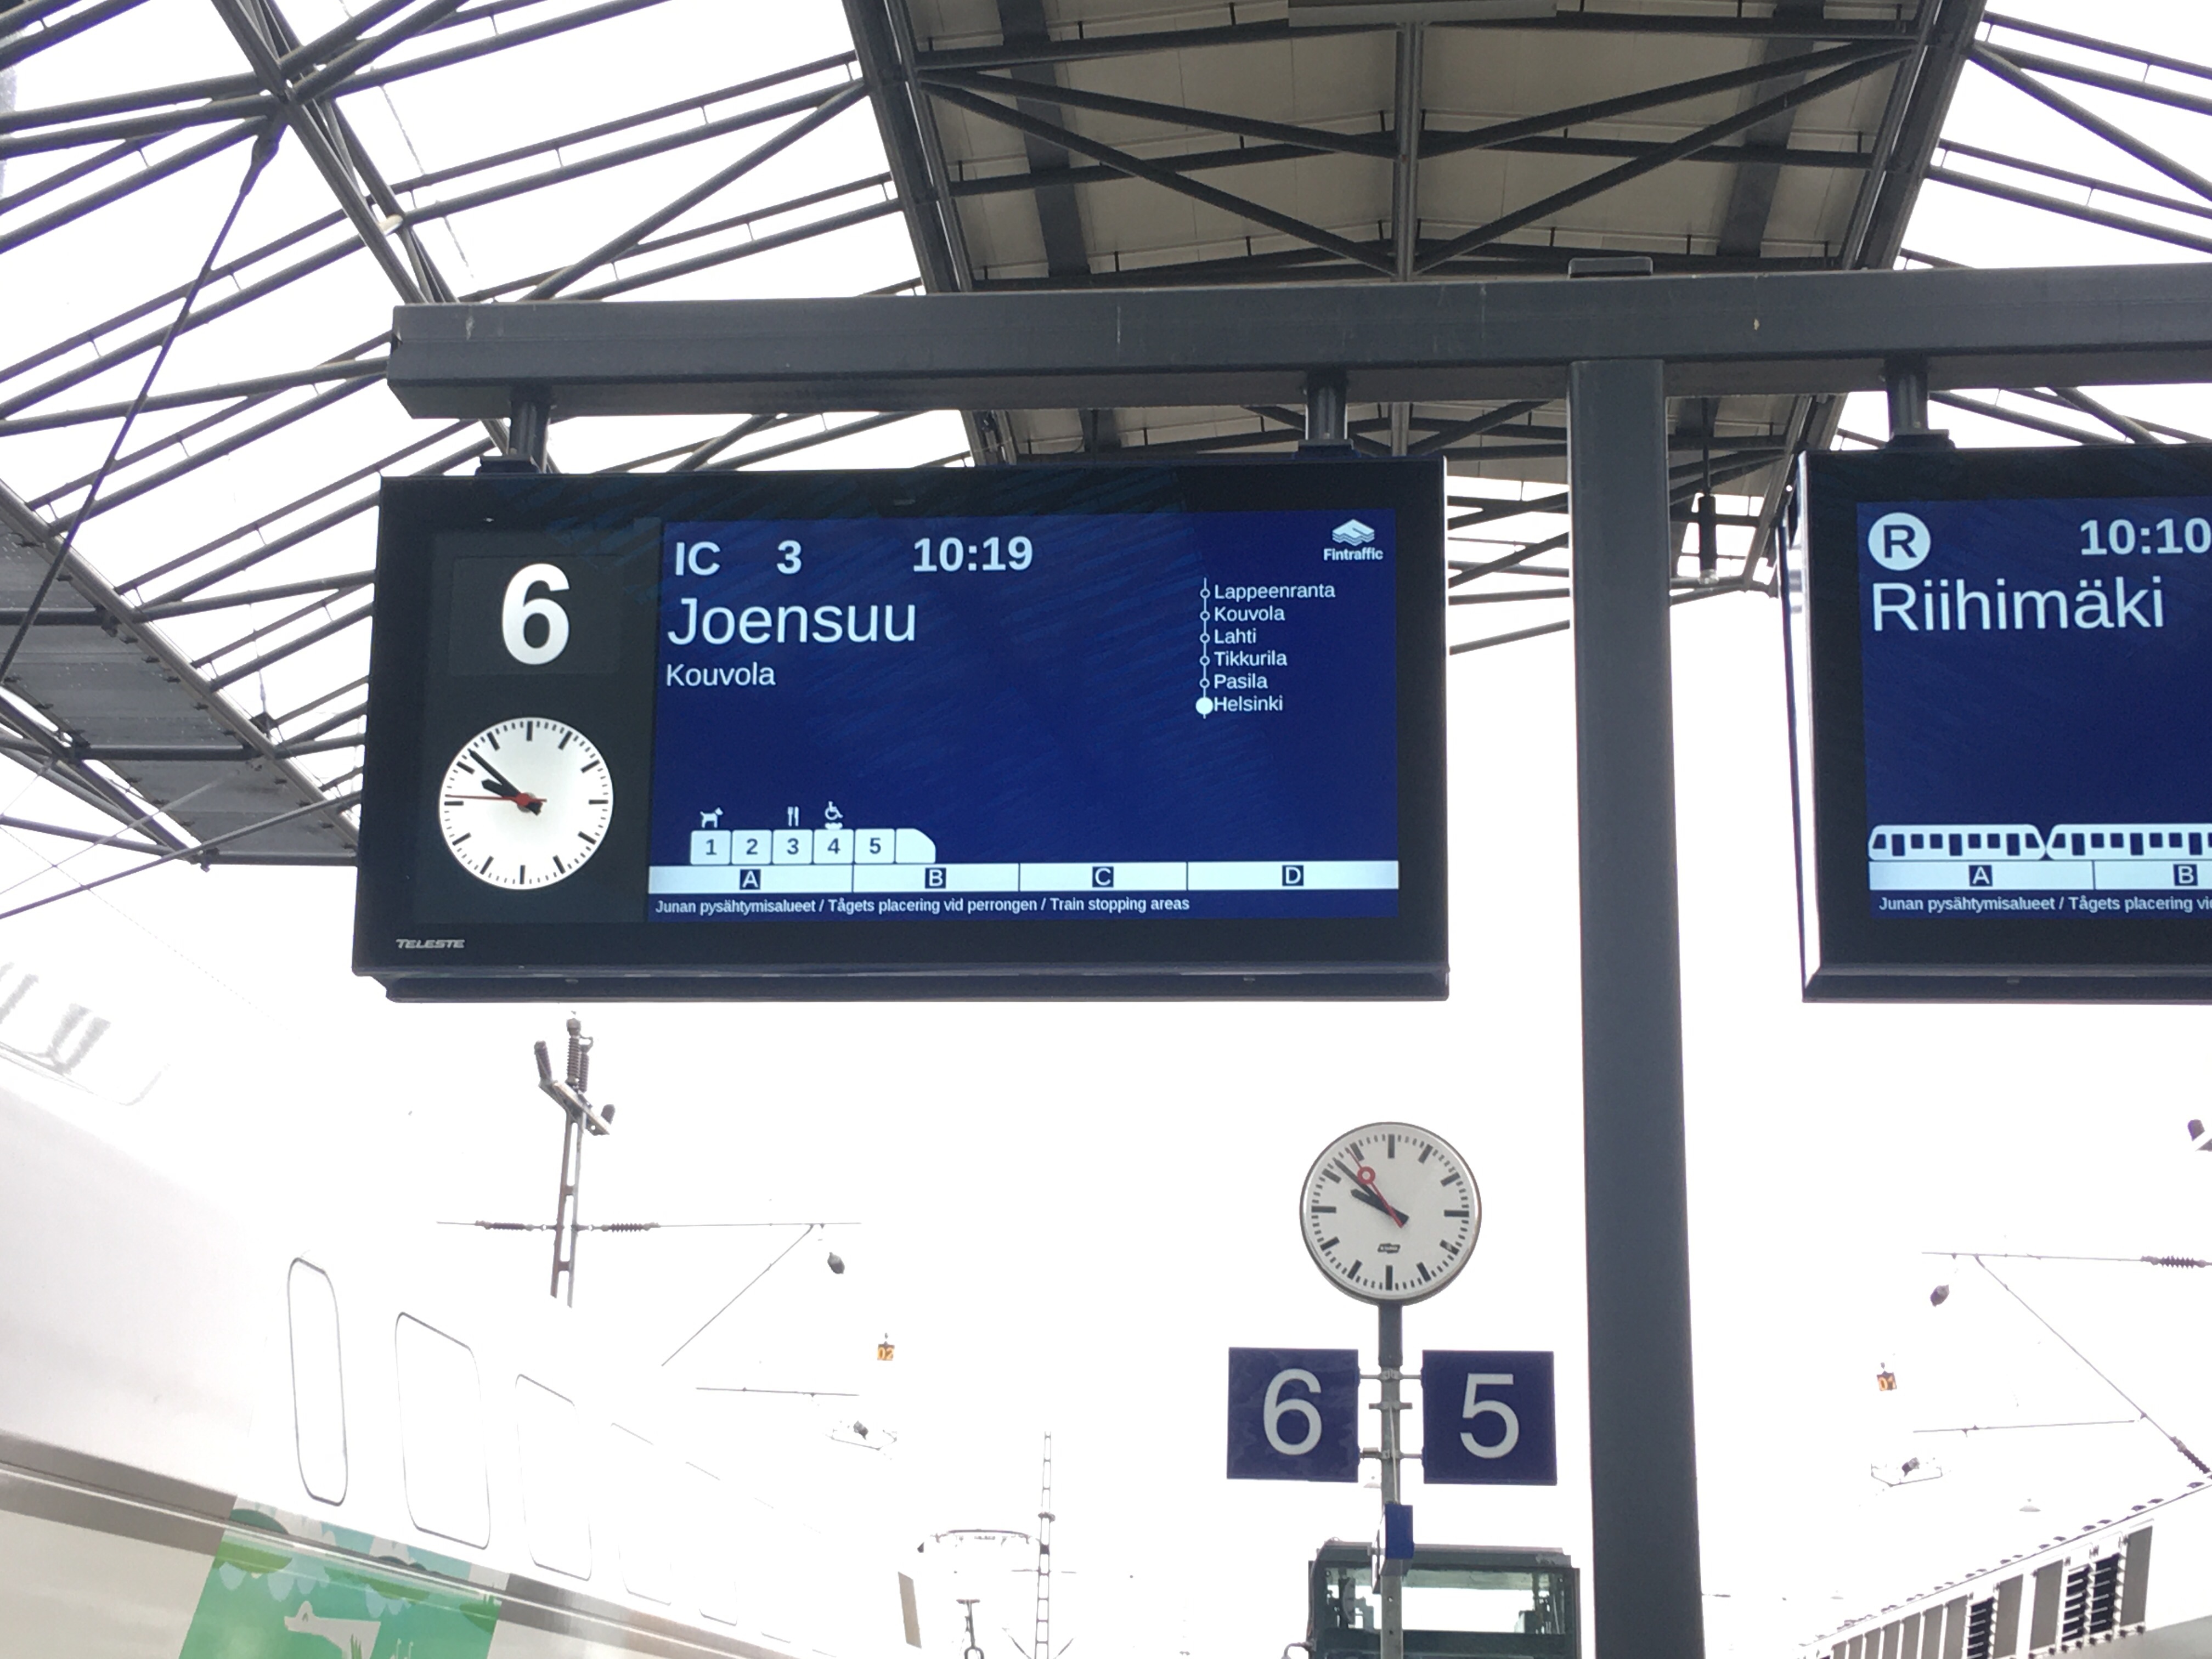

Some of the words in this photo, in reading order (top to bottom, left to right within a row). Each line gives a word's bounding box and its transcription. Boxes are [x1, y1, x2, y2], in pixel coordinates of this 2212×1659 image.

[2080, 517, 2211, 555] 10:10
[675, 541, 720, 575] IC
[776, 540, 802, 574] 3
[913, 536, 1032, 572] 10:19
[1323, 546, 1384, 561] Fintraffic
[1215, 584, 1336, 602] Lappeenranta
[1873, 575, 2163, 631] Riihimäki
[502, 563, 569, 665] 6
[668, 597, 915, 645] Joensuu
[1215, 605, 1285, 622] Kouvola
[1214, 628, 1256, 644] Lahti
[1214, 650, 1288, 667] Tikkurila
[667, 662, 776, 686] Kouvola
[1214, 673, 1268, 690] Pasila
[1214, 695, 1283, 712] Helsinki
[706, 839, 716, 855] 1
[746, 838, 758, 855] 2
[787, 838, 799, 855] 3
[827, 838, 840, 854] 4
[870, 838, 881, 854] 5
[742, 871, 759, 888] A
[929, 870, 943, 887] B
[1095, 867, 1111, 886] C
[1285, 866, 1301, 884] D
[1972, 866, 1990, 884] A
[2178, 865, 2194, 884] B
[655, 900, 696, 913] Junan
[699, 899, 816, 916] pysähtymisalueet
[827, 897, 875, 915] Tågets
[878, 898, 940, 915] placering
[944, 898, 963, 911] vid
[968, 900, 1037, 915] perrongen
[1049, 897, 1084, 911] Train
[1088, 896, 1147, 913] stopping
[1150, 899, 1190, 910] areas
[1879, 897, 1923, 910] Junan
[1927, 896, 2056, 913] pysähtymisalueet
[2068, 895, 2120, 913] Tågets
[2124, 896, 2193, 913] placering
[2196, 896, 2212, 910] vi
[396, 939, 465, 949] TELESTE
[1263, 1368, 1322, 1455] 6
[1460, 1373, 1519, 1459] 5
